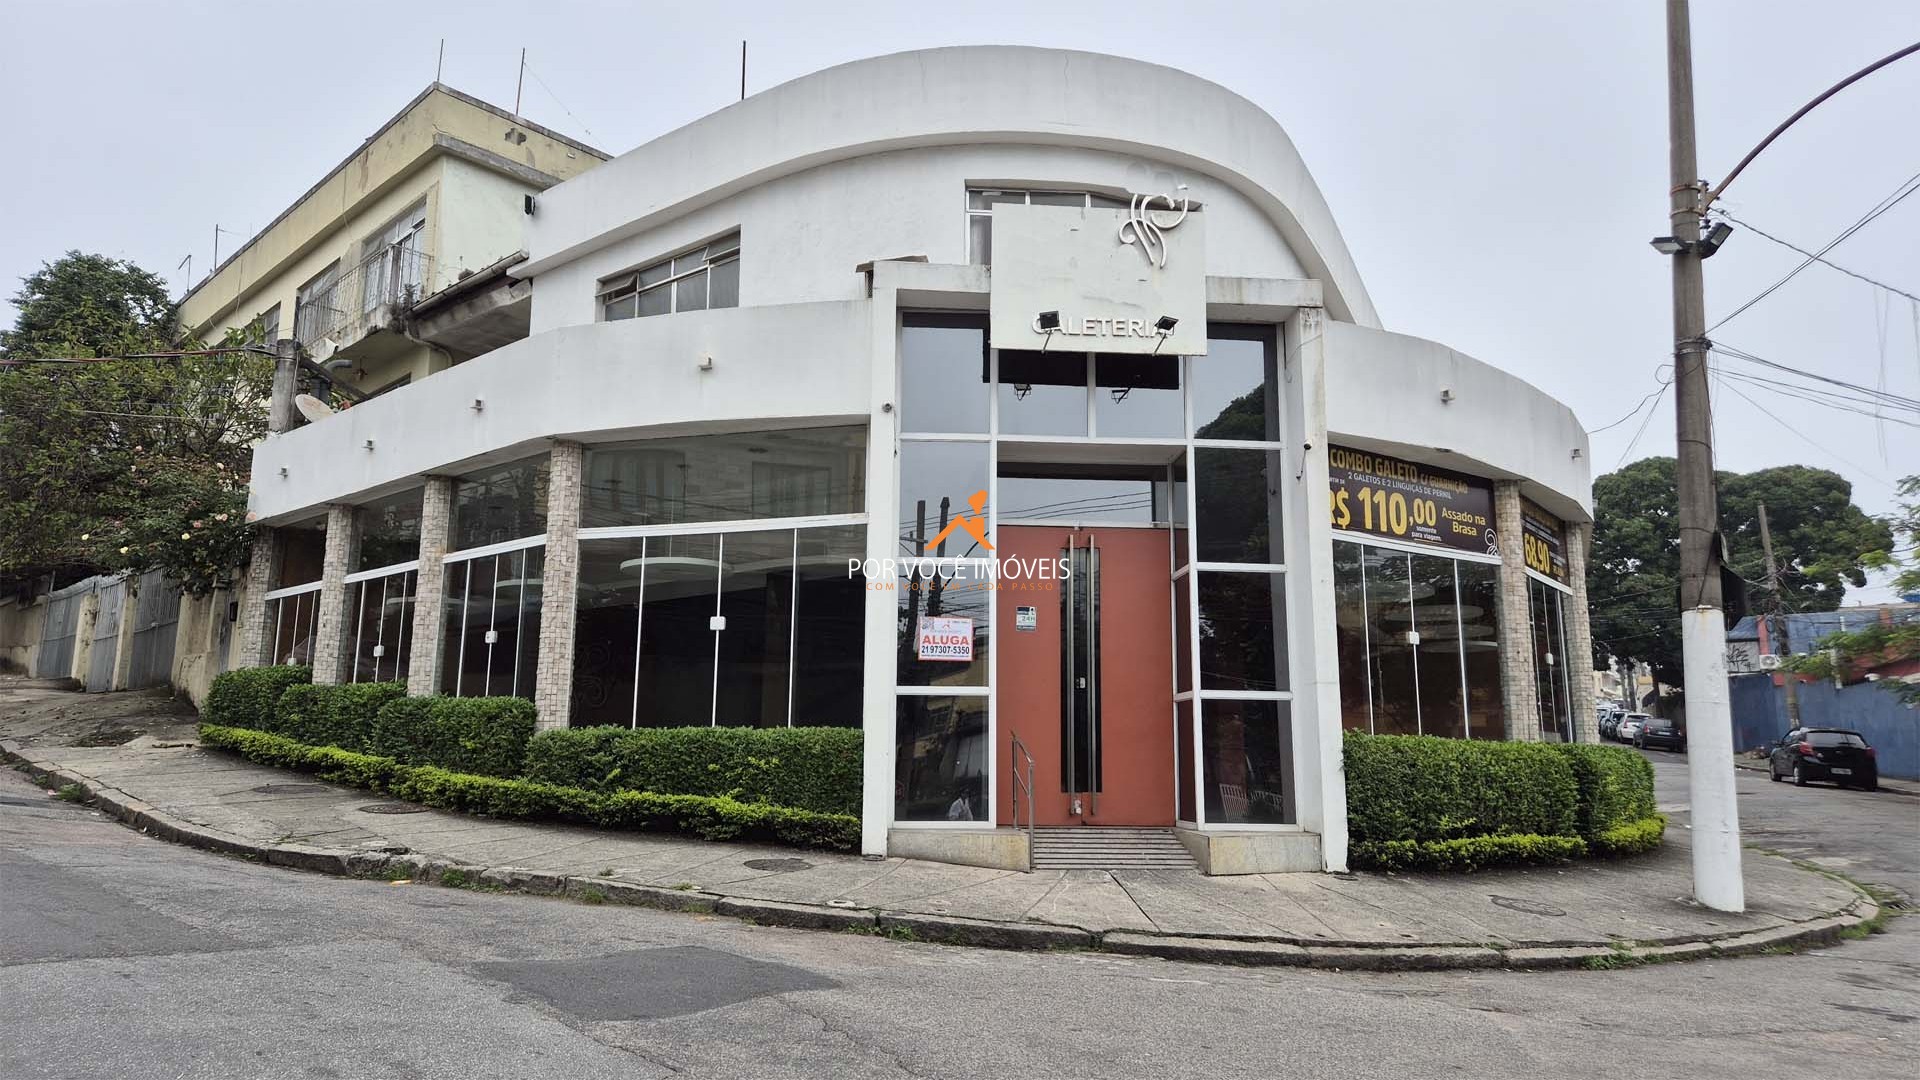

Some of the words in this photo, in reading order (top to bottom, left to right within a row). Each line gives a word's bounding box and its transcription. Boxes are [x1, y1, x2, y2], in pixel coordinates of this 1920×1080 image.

[1032, 317, 1168, 338] LETERI
[1330, 449, 1372, 473] COMBO
[1375, 456, 1418, 482] GALETO
[1347, 471, 1353, 480] 2
[1353, 472, 1381, 485] GALETOS
[1386, 479, 1391, 487] 2
[1357, 486, 1437, 535] 110,00
[1441, 507, 1473, 523] Assado
[1474, 515, 1486, 526] na
[1411, 531, 1423, 539] para
[1452, 521, 1477, 536] Brasa
[922, 634, 969, 646] ALUGA
